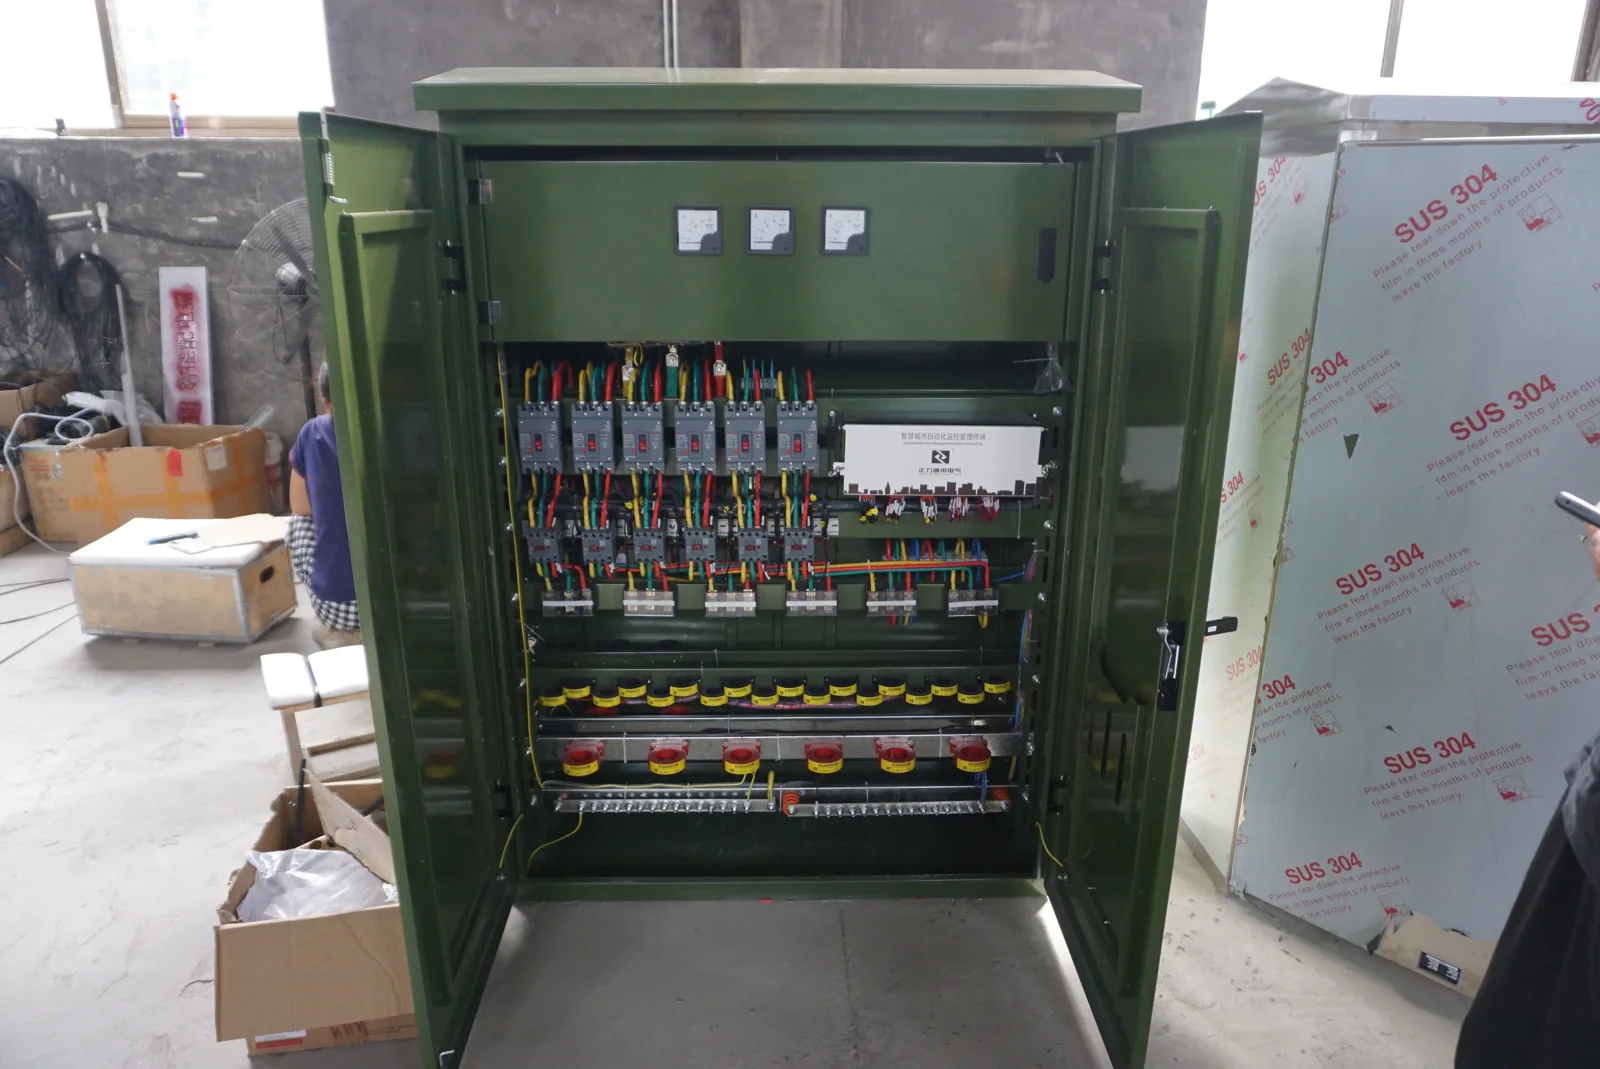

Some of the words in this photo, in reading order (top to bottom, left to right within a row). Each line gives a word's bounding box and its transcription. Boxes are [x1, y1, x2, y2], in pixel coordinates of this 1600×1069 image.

[1373, 251, 1410, 278] Please
[1411, 235, 1433, 252] tear
[1435, 213, 1466, 236] down
[1466, 198, 1487, 214] the
[1490, 154, 1550, 200] protective
[1394, 199, 1448, 243] SUS
[1450, 164, 1498, 205] 304
[1381, 273, 1403, 291] film
[1404, 266, 1415, 276] in
[1416, 245, 1446, 268] three
[1448, 215, 1491, 247] months
[1492, 203, 1505, 217] of
[1508, 166, 1563, 207] products
[1392, 280, 1421, 303] leave
[1422, 266, 1441, 282] the
[1441, 239, 1483, 269] factory
[1267, 352, 1290, 386] SUS
[1292, 328, 1310, 359] 304
[1310, 351, 1349, 384] 304
[1303, 391, 1324, 408] own
[1324, 380, 1341, 393] the
[1342, 349, 1391, 383] protective
[1310, 395, 1345, 419] months
[1345, 386, 1356, 397] of
[1358, 360, 1401, 391] products
[1305, 416, 1338, 438] factory
[1450, 402, 1505, 441] SUS
[1507, 374, 1556, 410] 304
[1426, 449, 1465, 472] Please
[1466, 435, 1489, 452] tear
[1492, 418, 1524, 438] down
[1524, 406, 1545, 421] the
[1459, 463, 1471, 474] in
[1472, 448, 1503, 468] three
[1505, 422, 1549, 450] months
[1550, 414, 1564, 426] of
[1228, 470, 1244, 496] 304
[1445, 478, 1476, 498] leave
[1478, 467, 1497, 481] the
[1498, 446, 1541, 471] factory
[1317, 602, 1349, 619] Please
[1350, 592, 1369, 607] tear
[1372, 579, 1398, 595] down
[1398, 571, 1416, 583] the
[1418, 547, 1470, 575] protective
[1335, 563, 1382, 595] SUS
[1384, 542, 1424, 573] 304
[1324, 620, 1343, 632] film
[1344, 615, 1353, 624] in
[1355, 603, 1381, 619] three
[1382, 586, 1420, 608] months
[1421, 579, 1432, 590] of
[1433, 559, 1481, 585] products
[1332, 628, 1359, 644] leave
[1360, 621, 1377, 633] the
[1377, 605, 1413, 625] factory
[1531, 612, 1591, 647] SUS
[1226, 657, 1246, 681] SUS
[1506, 654, 1546, 673] Please
[1549, 644, 1573, 658] tear
[1515, 674, 1538, 688] film
[1540, 669, 1552, 679] in
[1554, 658, 1587, 674] three
[1256, 705, 1274, 717] own
[1274, 699, 1288, 709] the
[1290, 682, 1332, 704] protective
[1262, 674, 1295, 699] 304
[1525, 685, 1558, 701] leave
[1560, 677, 1581, 689] the
[1261, 713, 1292, 729] months
[1293, 707, 1302, 716] of
[1304, 693, 1342, 713] products
[1258, 729, 1286, 744] factory
[1384, 746, 1432, 774] SUS
[1433, 732, 1476, 758] 304
[1364, 781, 1397, 795] Please
[1399, 774, 1418, 785] tear
[1420, 765, 1447, 778] down
[1448, 759, 1466, 770] the
[1468, 741, 1522, 765] protective
[1371, 796, 1390, 808] film
[1391, 792, 1401, 801] in
[1403, 786, 1429, 800] three
[1431, 773, 1469, 790] months
[1471, 769, 1483, 779] of
[1485, 754, 1534, 775] products
[1380, 806, 1406, 821] leave
[1407, 801, 1425, 812] the
[1425, 791, 1462, 807] factory
[1269, 890, 1297, 901] Please
[1299, 885, 1314, 894] tear
[1317, 880, 1339, 890] down
[1340, 875, 1355, 884] the
[1357, 864, 1401, 880] protective
[1284, 861, 1326, 885] SUS
[1327, 852, 1363, 874] 304
[1301, 896, 1325, 907] three
[1326, 888, 1358, 901] months
[1370, 876, 1411, 892] products
[1307, 910, 1322, 920] the
[1322, 904, 1353, 917] factory
